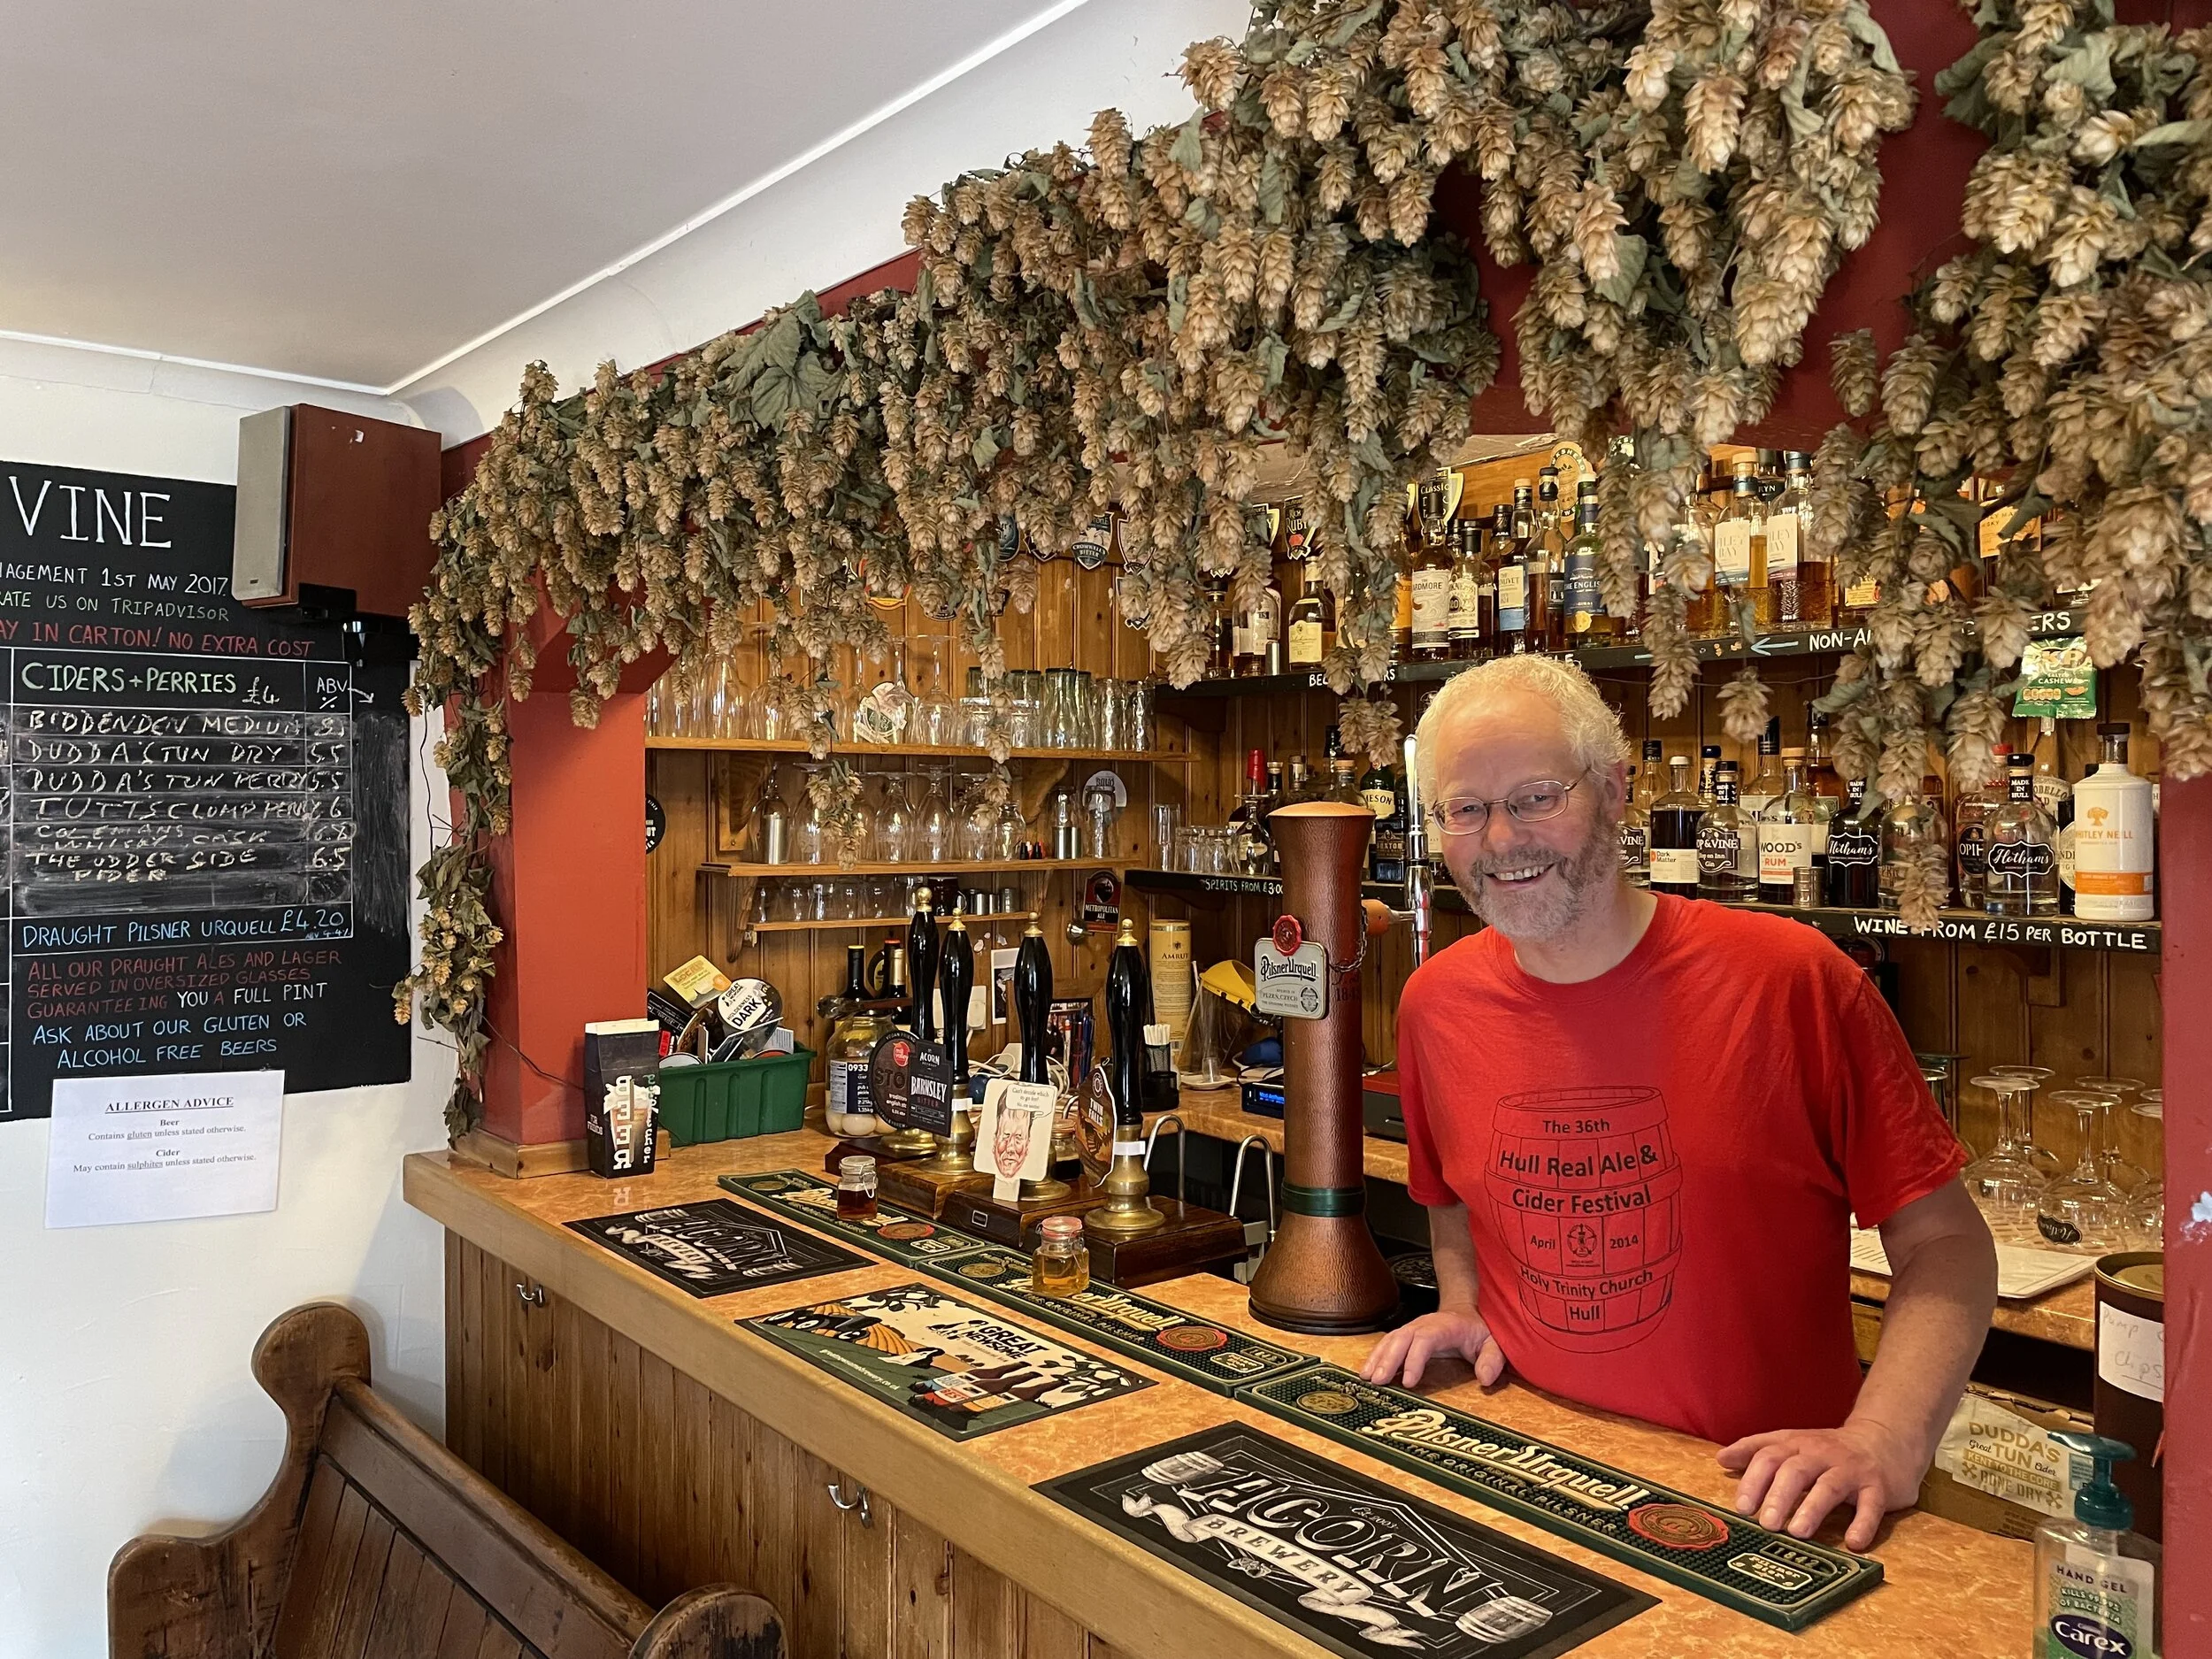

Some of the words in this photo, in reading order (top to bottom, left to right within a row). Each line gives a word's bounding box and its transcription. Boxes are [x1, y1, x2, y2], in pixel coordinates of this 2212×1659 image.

[9, 475, 173, 549] VINE
[102, 569, 136, 588] 1ST
[148, 573, 177, 591] MAY
[46, 594, 67, 610] US
[77, 595, 98, 611] ON
[111, 598, 229, 621] TRIPADVISOR
[33, 623, 59, 642] IN
[69, 625, 162, 649] CARTON!
[169, 631, 193, 651] NO
[202, 633, 258, 655] EXTRA
[267, 639, 315, 657] COST
[242, 676, 280, 705] £4
[316, 677, 348, 694] ABV
[160, 745, 210, 764] TUN
[230, 742, 283, 764] DRY
[165, 772, 225, 789] TUN
[26, 852, 81, 868] THE
[1764, 858, 1786, 867] RUM
[1205, 878, 1238, 892] SPIRITS
[1240, 881, 1261, 894] FROM
[1085, 904, 1118, 914] METROPOLITAN
[23, 926, 117, 948] DRAUGHT
[128, 920, 191, 943] PILSNER
[201, 919, 277, 937] URQUELL
[280, 910, 344, 932] £4.20
[1854, 916, 1909, 935] WINE
[1984, 922, 2020, 943] £15
[2026, 926, 2052, 942] PER
[2061, 929, 2148, 950] BOTTLE
[29, 961, 62, 981] ALL
[68, 960, 104, 977] OUR
[111, 956, 188, 975] DRAUGHT
[197, 949, 235, 971] ALES
[243, 951, 274, 968] AND
[281, 949, 342, 965] LAGER
[1287, 956, 1317, 981] Urquell
[27, 982, 101, 999] SERVED
[108, 979, 128, 994] IN
[134, 972, 229, 991] OVERSIZED
[236, 969, 310, 984] GLASSES
[177, 991, 208, 1009] YOU
[214, 991, 224, 1006] A
[234, 987, 272, 1004] FULL
[284, 982, 328, 1002] PINT
[732, 997, 763, 1028] DARK
[33, 1025, 73, 1045] ASK
[85, 1021, 144, 1042] ABOUT
[153, 1018, 191, 1034] OUR
[204, 1015, 269, 1033] GLUTEN
[284, 1012, 307, 1026] OR
[57, 1048, 146, 1069] ALCOHOL
[157, 1044, 204, 1061] FREE
[220, 1039, 277, 1056] BEERS
[919, 1052, 941, 1066] ACORN
[848, 1064, 869, 1072] 0933
[910, 1076, 948, 1103] BARNSLEY
[105, 1099, 180, 1113] ALLERGEN
[183, 1096, 234, 1109] ADVICE
[1088, 1108, 1103, 1127] FALLS
[1089, 1097, 1104, 1115] TWIN
[88, 1132, 125, 1141] Contains
[127, 1130, 152, 1141] gluten
[154, 1129, 180, 1138] unless
[181, 1126, 204, 1136] stated
[159, 1118, 180, 1127] Beer
[1543, 1120, 1571, 1133] The
[1576, 1118, 1610, 1133] 36th
[73, 1164, 93, 1174] May
[95, 1161, 126, 1171] contain
[165, 1157, 190, 1167] unless
[192, 1156, 215, 1164] stated
[156, 1148, 180, 1157] Cider
[1500, 1150, 1540, 1175] Hull
[1548, 1156, 1594, 1178] Real
[1601, 1151, 1637, 1175] Ale
[1640, 1144, 1659, 1165] &
[1512, 1187, 1564, 1213] Cider
[1571, 1184, 1652, 1214] Festival
[1530, 1234, 1556, 1250] April
[1609, 1235, 1639, 1249] 2014
[1520, 1265, 1549, 1292] Holy
[1553, 1280, 1595, 1300] Trinity
[1600, 1270, 1653, 1295] Church
[1096, 1292, 1187, 1332] Urquell
[1570, 1305, 1600, 1320] Hull
[2101, 1306, 2139, 1340] Pump
[963, 1331, 1027, 1360] NEWSOME
[979, 1325, 1049, 1354] GREAT
[939, 1388, 970, 1402] BEST
[1969, 1421, 2062, 1464] DUDDA'S
[1361, 1409, 1520, 1461] Pilsner
[1510, 1445, 1651, 1509] Urquell
[1967, 1452, 1993, 1467] KENT
[1994, 1460, 2008, 1472] TO
[2008, 1463, 2028, 1479] THE
[2029, 1472, 2058, 1490] CORE
[1969, 1440, 1993, 1454] Great
[1991, 1442, 2034, 1470] TUN
[2034, 1461, 2058, 1477] Cider
[1408, 1443, 1441, 1461] THE
[1442, 1458, 1528, 1498] ORIGINAL
[1534, 1495, 1618, 1532] PILSNER
[2016, 1484, 2044, 1504] DRY
[1177, 1471, 1504, 1618] ACORN
[1203, 1517, 1363, 1595] BREWERY
[1774, 1546, 1821, 1569] 1842
[2057, 1565, 2095, 1586] HAND
[2100, 1578, 2128, 1594] GEL
[2060, 1586, 2087, 1600] KILLS
[2054, 1620, 2127, 1657] Carex
